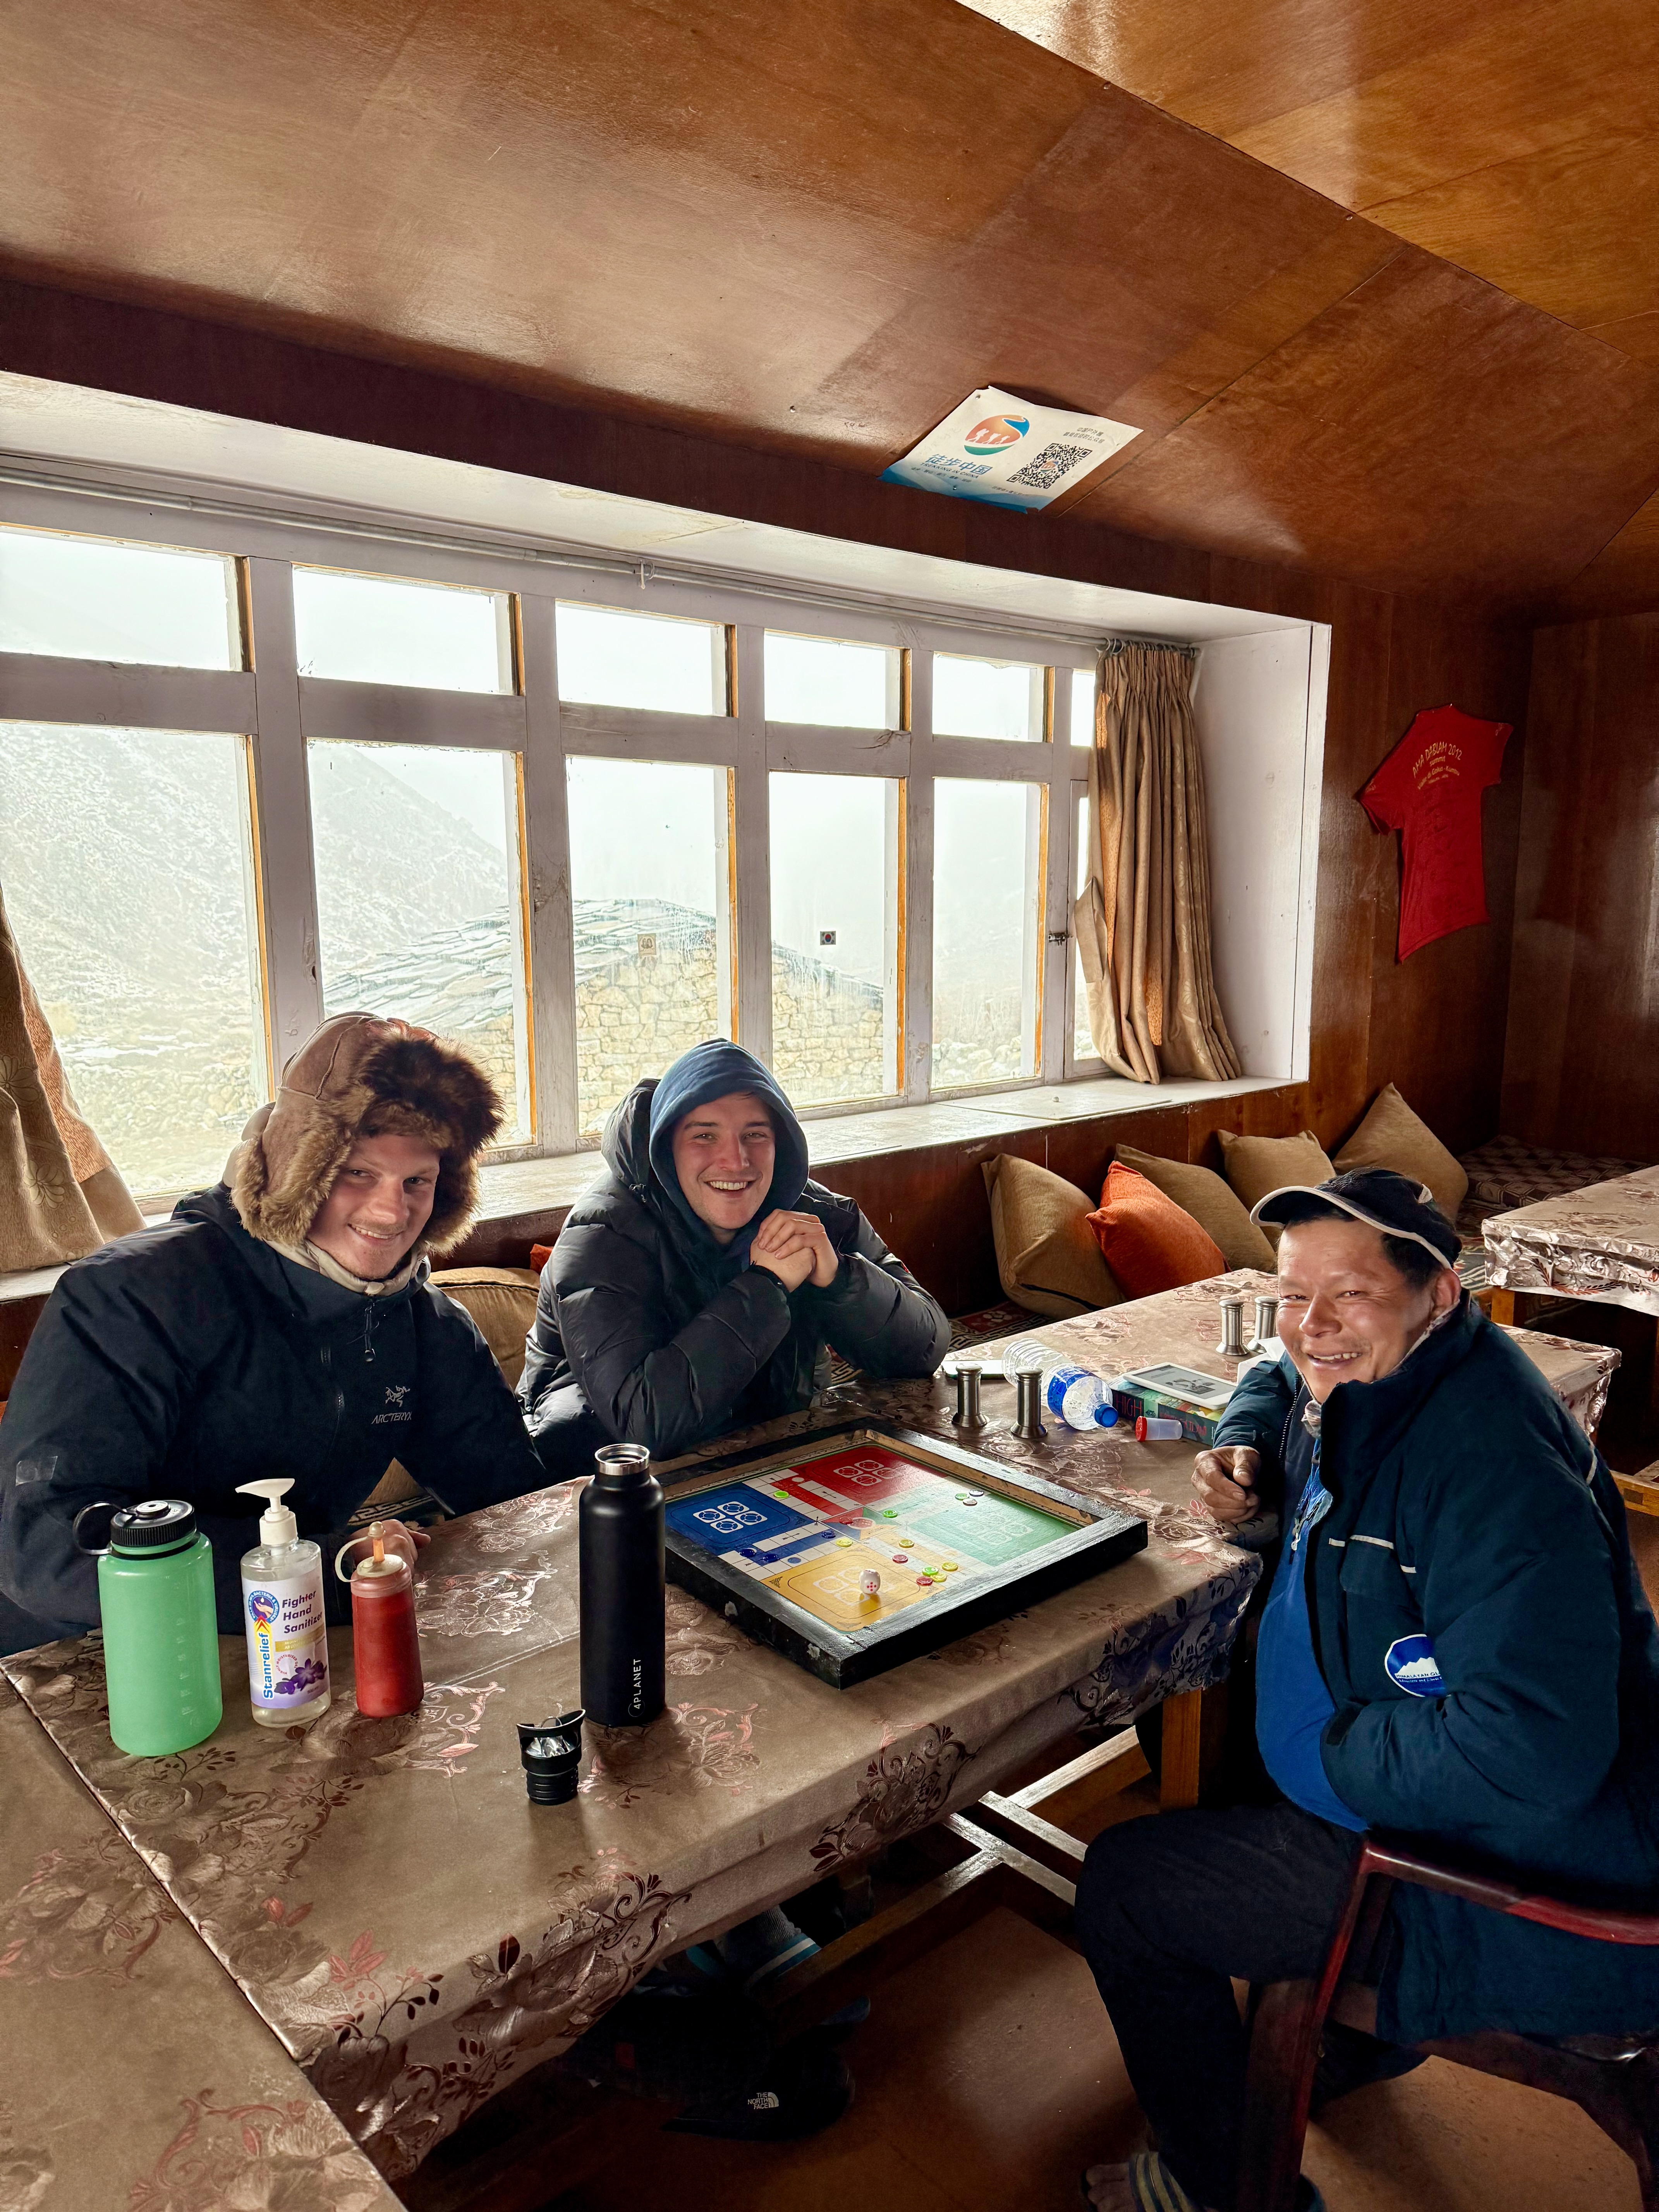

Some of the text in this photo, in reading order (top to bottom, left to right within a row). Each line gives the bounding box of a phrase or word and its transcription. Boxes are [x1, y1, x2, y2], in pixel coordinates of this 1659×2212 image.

[921, 463, 951, 471] TREKKING
[925, 454, 993, 475] 徒步中国
[1413, 741, 1462, 778] AMA DABLAM 2012
[1116, 1394, 1142, 1418] HIGH
[282, 1590, 316, 1608] Fighter
[283, 1604, 311, 1621] Hand
[284, 1612, 322, 1633] Sanitizer
[259, 1633, 273, 1698] Stanrelief
